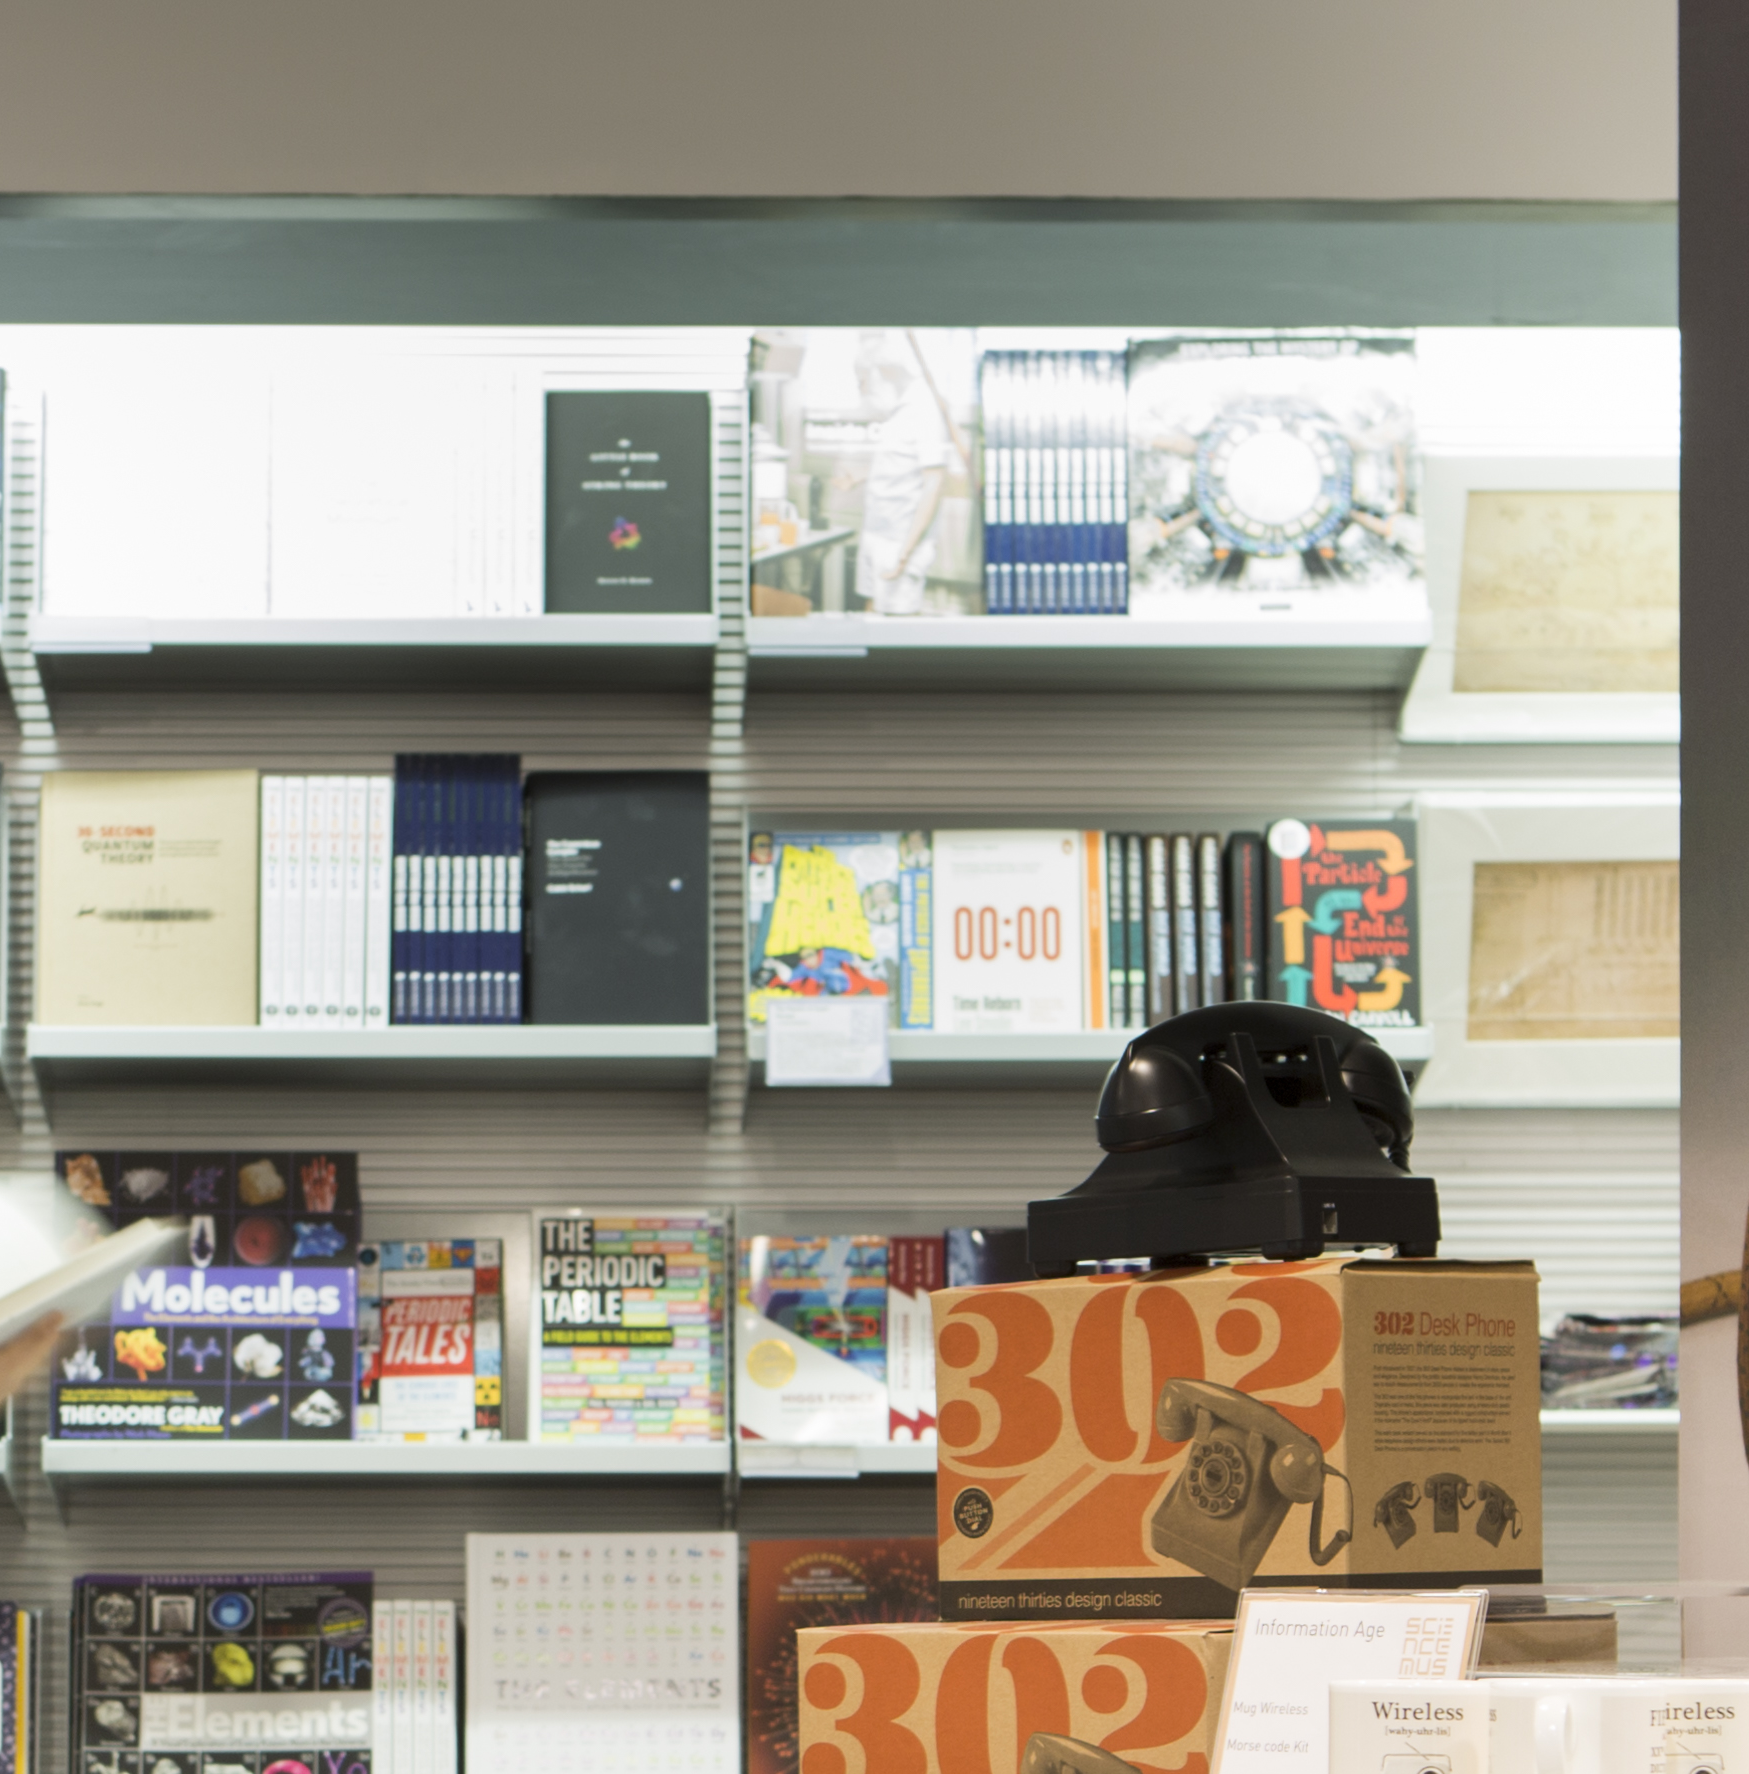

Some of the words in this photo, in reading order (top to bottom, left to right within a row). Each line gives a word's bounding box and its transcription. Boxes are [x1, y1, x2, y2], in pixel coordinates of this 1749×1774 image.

[101, 853, 155, 864] THEORY
[954, 905, 1061, 961] 00:00
[1343, 910, 1386, 938] End
[542, 1220, 593, 1252] THE
[542, 1255, 665, 1288] PERIODIC
[121, 1269, 341, 1315] Molecules
[384, 1298, 472, 1326] PERIODIC
[542, 1289, 622, 1324] TABLE
[1374, 1311, 1415, 1336] 302
[1420, 1311, 1460, 1337] Desk
[1465, 1312, 1516, 1338] Phone
[383, 1322, 471, 1365] TALES
[1372, 1341, 1414, 1356] nineteen
[1416, 1340, 1447, 1357] thirties
[1449, 1341, 1481, 1360] design
[1483, 1342, 1516, 1358] classic
[937, 1276, 1347, 1467] 302
[59, 1405, 166, 1426] THEODORE
[167, 1405, 225, 1426] GRAY
[959, 1507, 989, 1520] BUTTON
[963, 1502, 982, 1512] PUSH
[958, 1592, 1015, 1609] nineteen
[1018, 1591, 1062, 1609] thirties
[1065, 1590, 1112, 1611] design
[1115, 1589, 1163, 1608] classic
[1255, 1617, 1349, 1638] Information
[1353, 1619, 1386, 1643] Age
[322, 1646, 372, 1685] Ar
[169, 1699, 369, 1740] Elements
[1233, 1702, 1257, 1716] Mug
[1260, 1701, 1309, 1716] Wireless
[1372, 1701, 1464, 1721] Wireless
[1227, 1738, 1261, 1752] Morse
[1264, 1738, 1290, 1753] code
[1293, 1739, 1309, 1753] Kit
